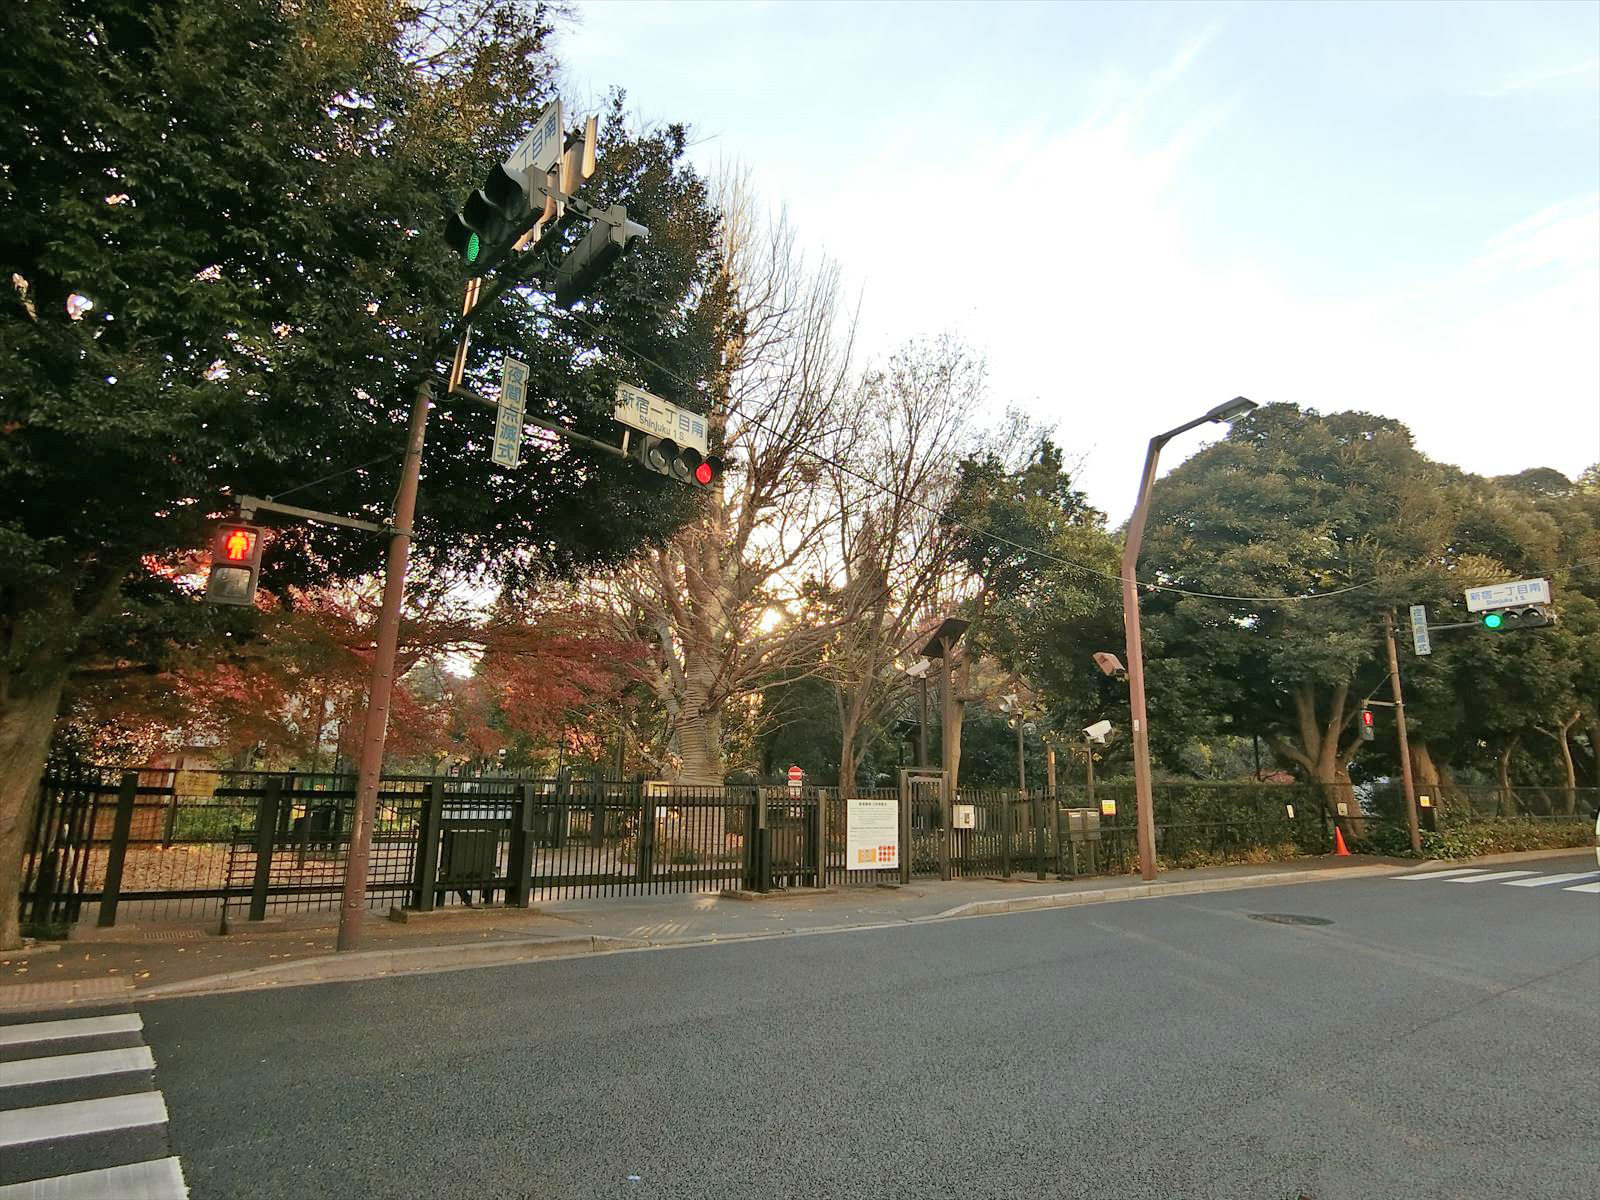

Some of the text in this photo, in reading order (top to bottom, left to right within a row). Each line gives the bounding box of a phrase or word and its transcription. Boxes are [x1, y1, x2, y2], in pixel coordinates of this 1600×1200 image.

[496, 364, 526, 462] 夜間点滅式
[620, 389, 704, 438] 新宿一丁目南
[639, 414, 671, 436] Shinjuku
[1470, 582, 1541, 601] 新宿一丁目南
[1486, 597, 1513, 606] Shinjuku
